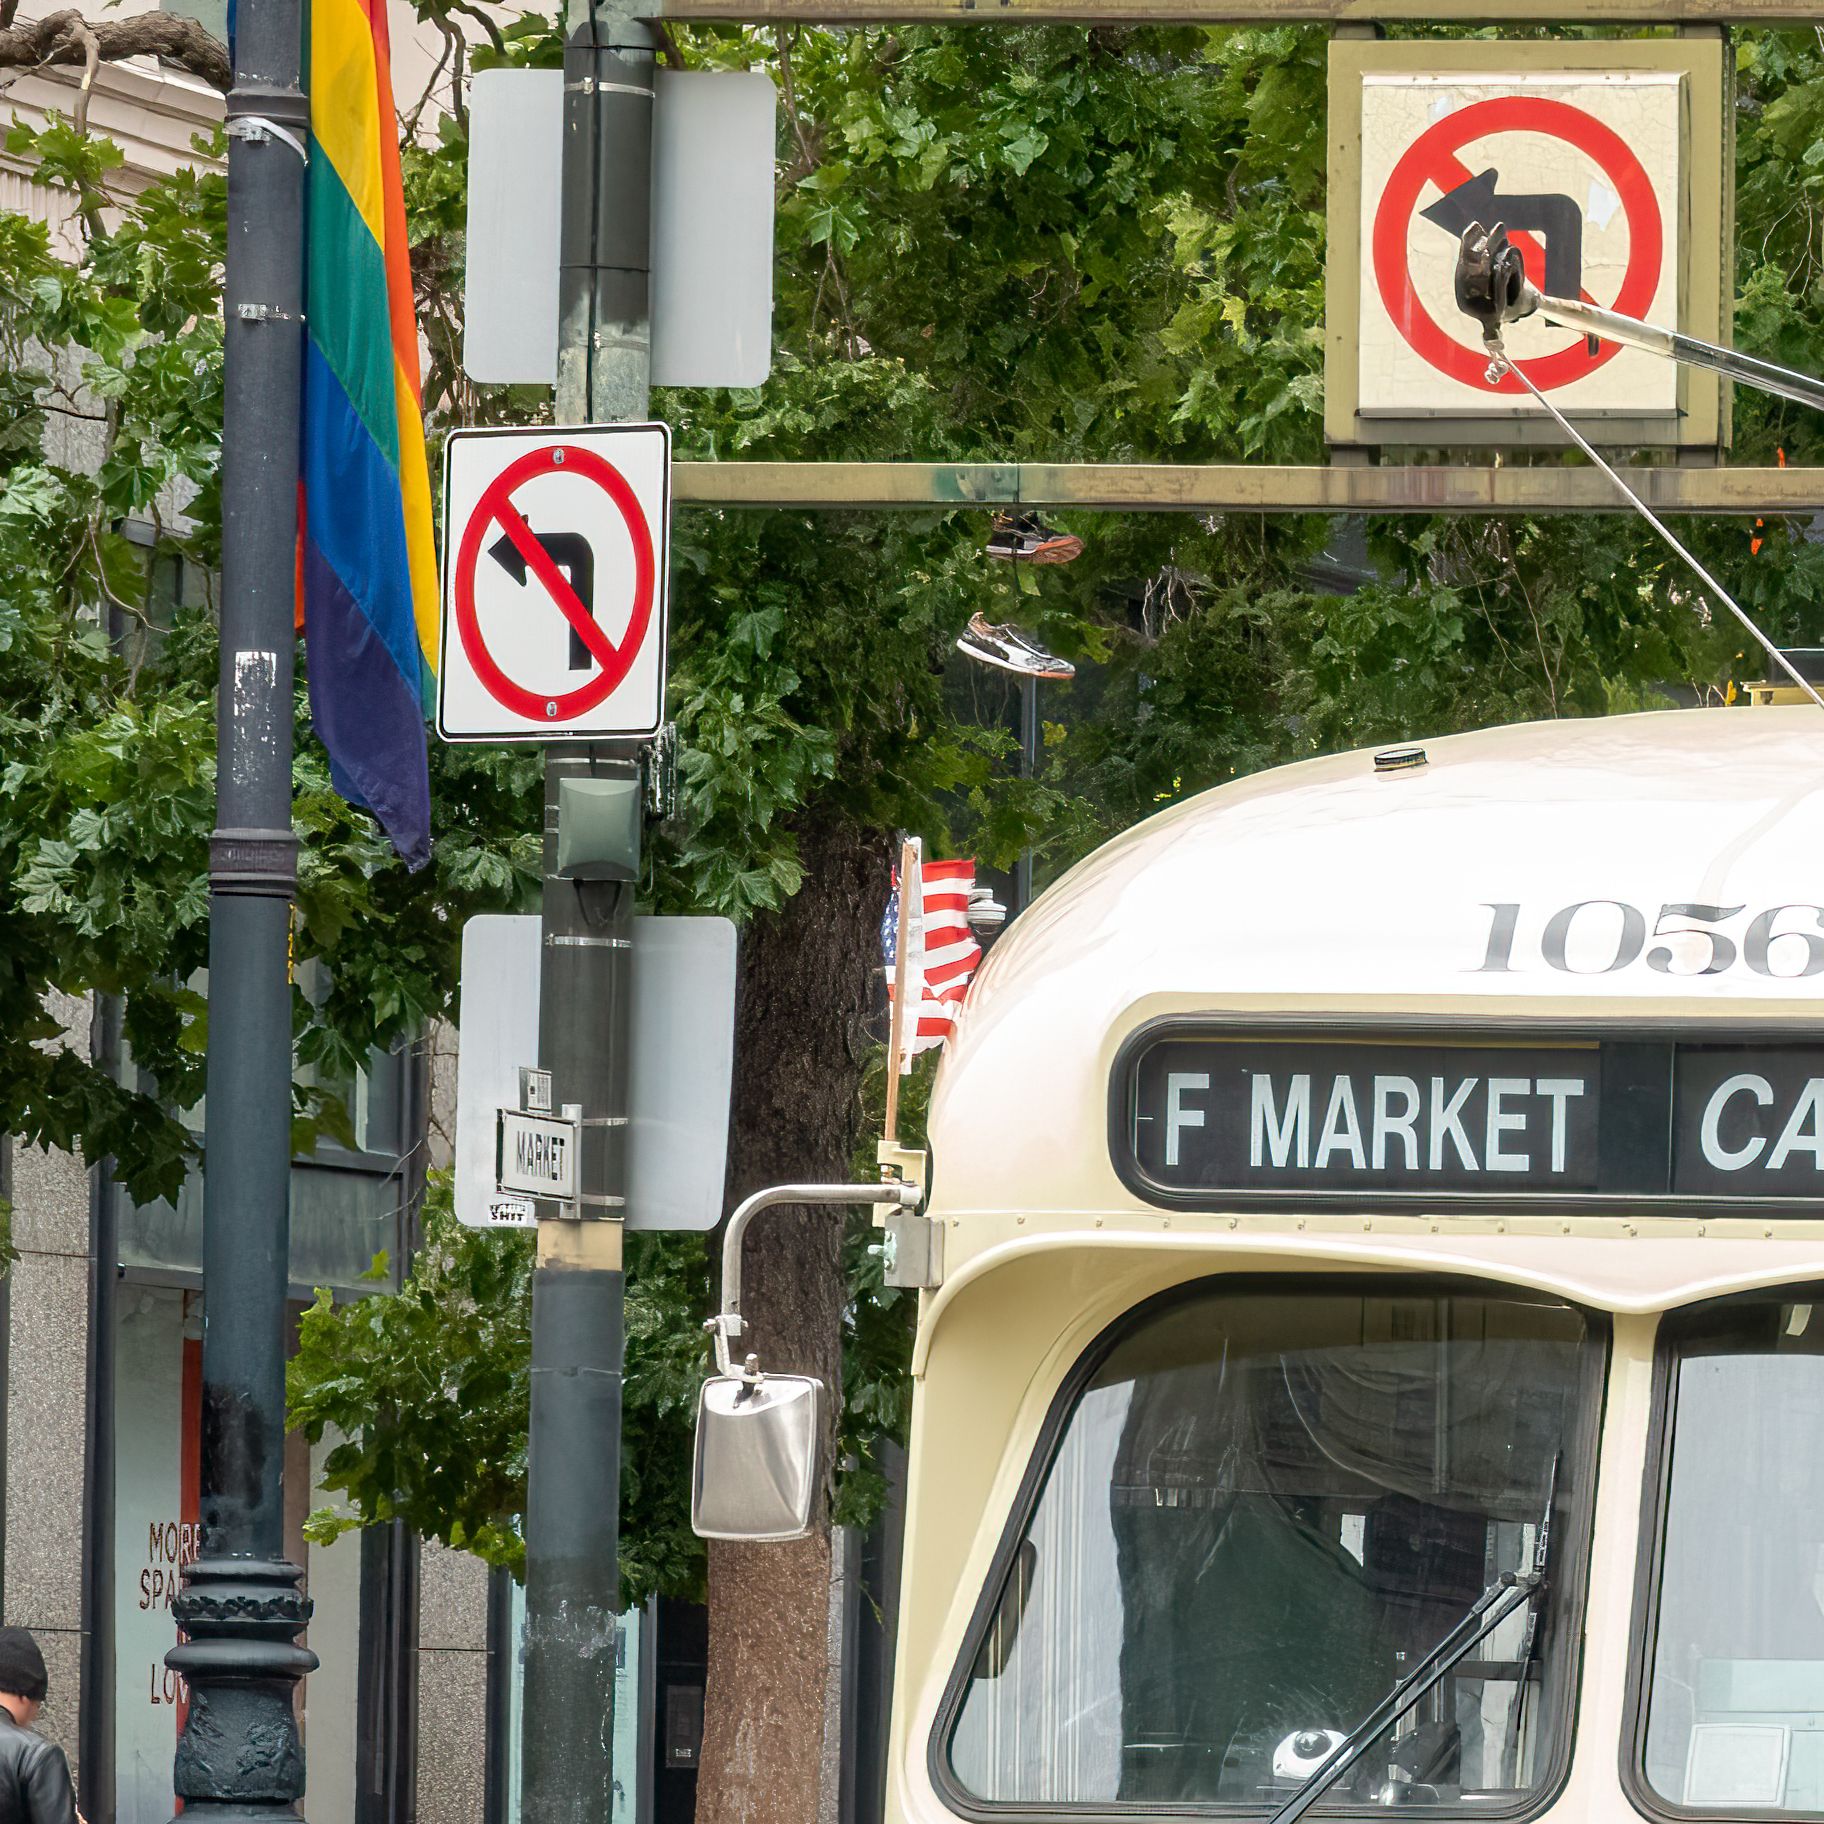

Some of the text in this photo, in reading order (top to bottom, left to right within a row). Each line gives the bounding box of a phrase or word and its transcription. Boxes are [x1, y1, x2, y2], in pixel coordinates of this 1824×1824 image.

[516, 1129, 566, 1181] MARKET
[1166, 1073, 1210, 1166] F
[1250, 1074, 1585, 1173] MARKET
